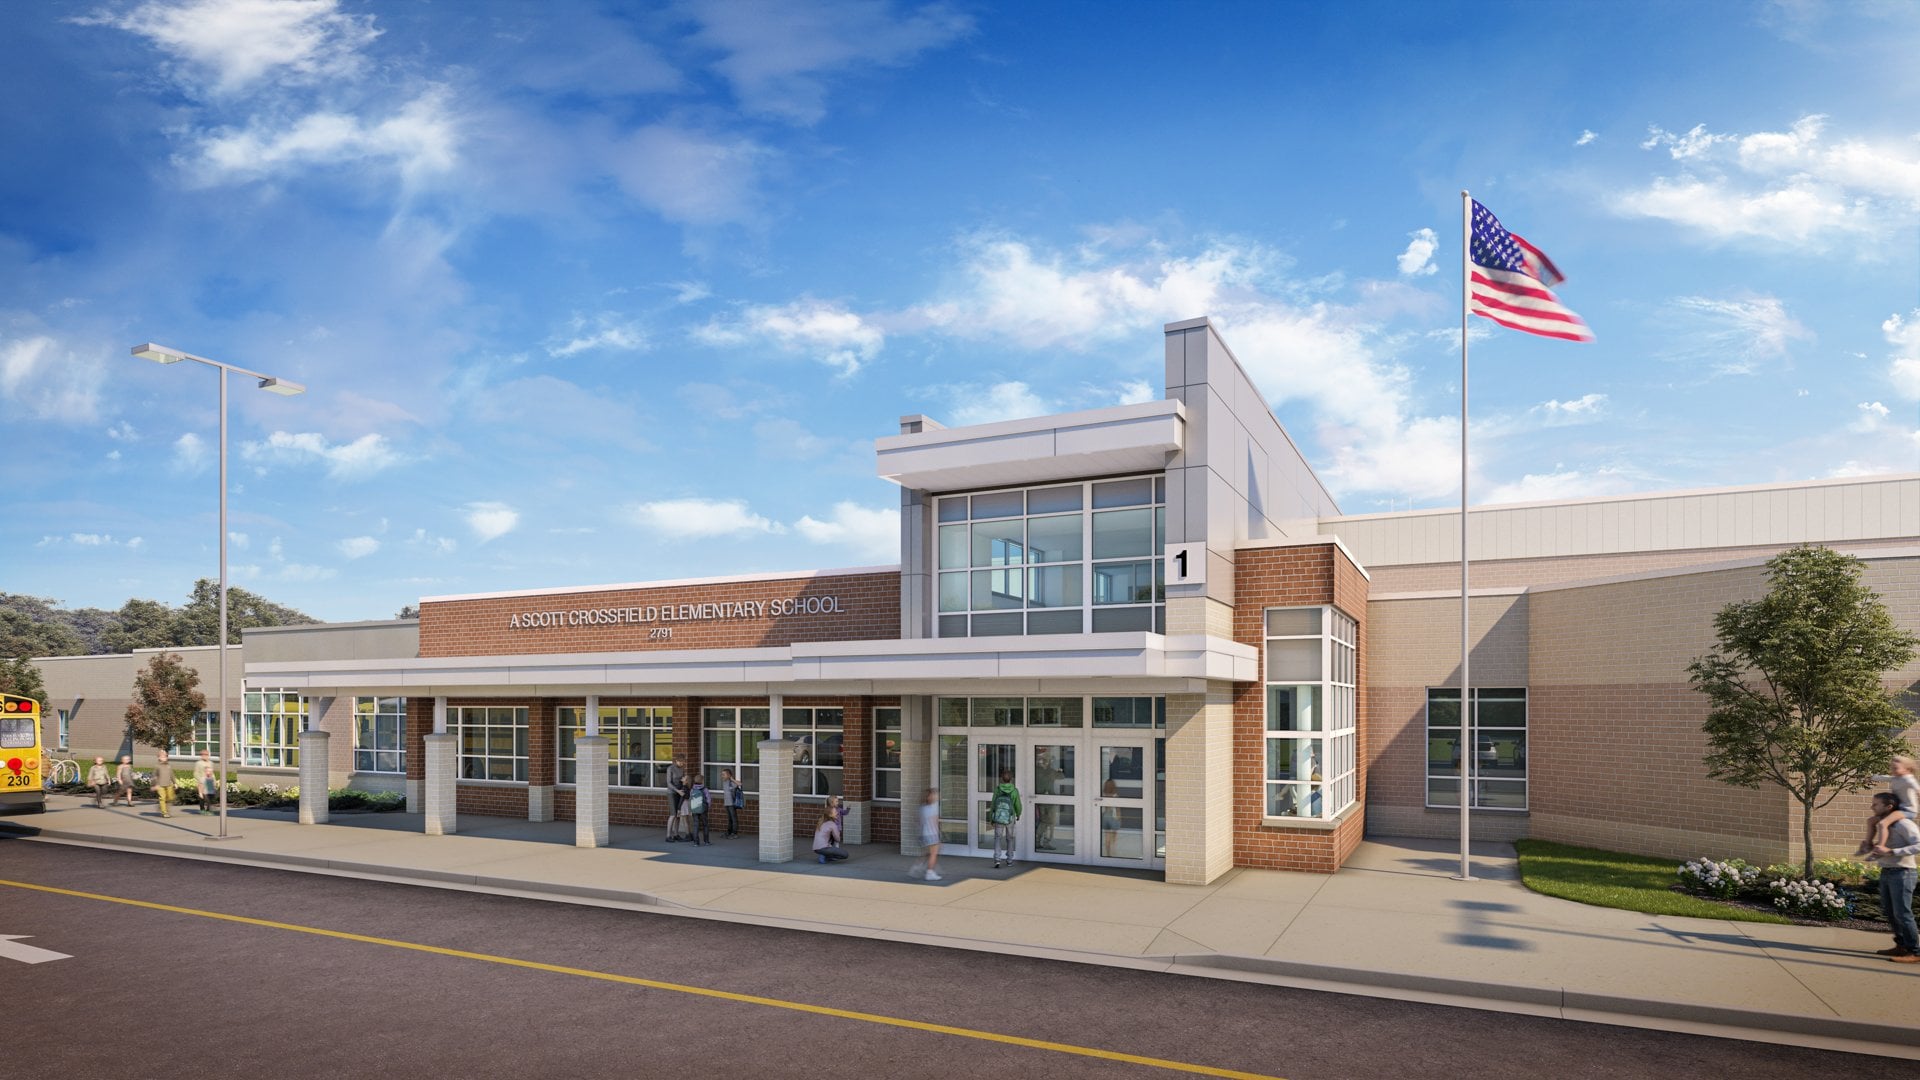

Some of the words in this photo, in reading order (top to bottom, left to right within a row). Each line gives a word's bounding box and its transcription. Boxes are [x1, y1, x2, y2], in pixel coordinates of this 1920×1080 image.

[1175, 549, 1187, 577] 1
[510, 614, 519, 628] A
[522, 611, 566, 627] SCOTT
[568, 607, 656, 625] CROSSFIELD
[661, 600, 766, 621] ELEMENTARY
[770, 596, 845, 616] SCHOOL
[650, 627, 672, 638] 2791
[7, 775, 30, 787] 230
